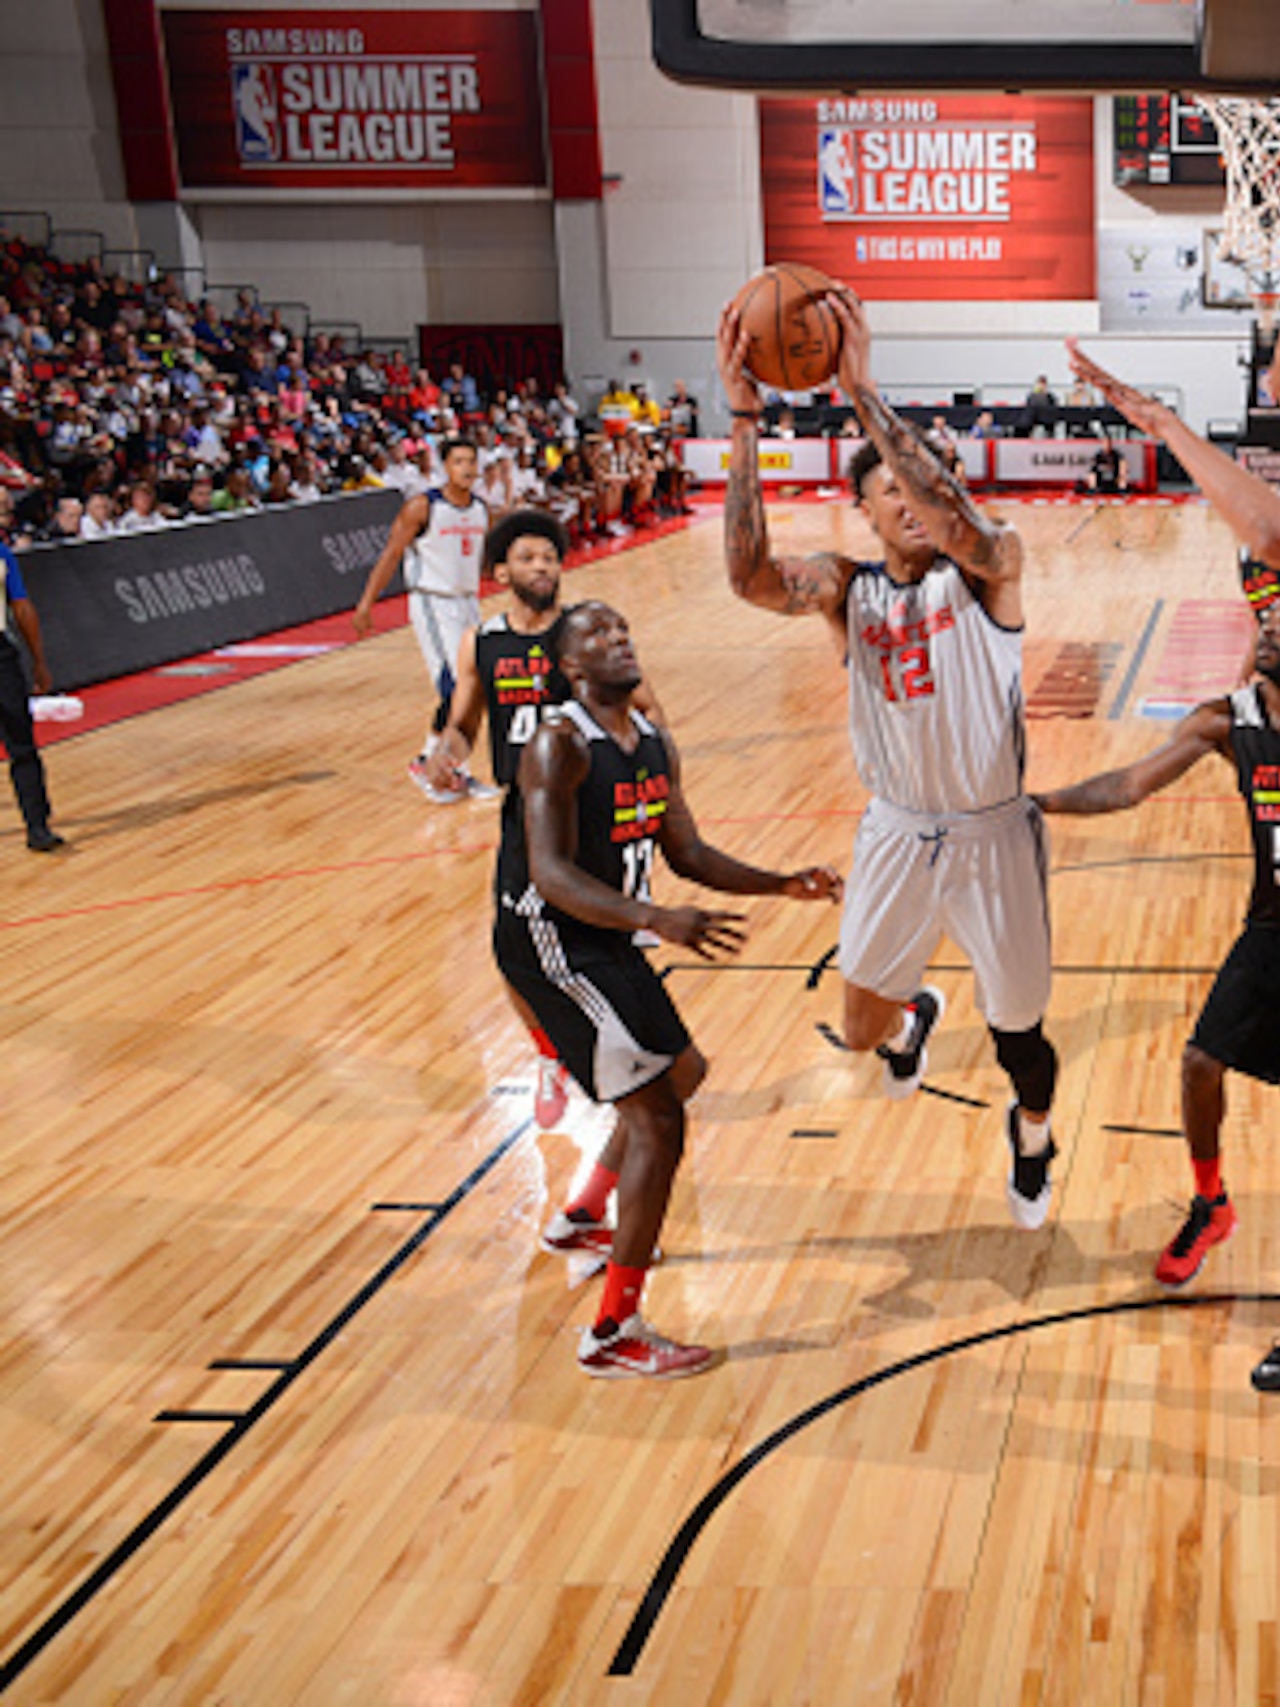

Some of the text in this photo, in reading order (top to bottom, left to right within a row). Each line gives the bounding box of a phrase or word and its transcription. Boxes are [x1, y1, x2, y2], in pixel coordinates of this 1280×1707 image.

[227, 29, 364, 54] SAMSUNG
[282, 65, 480, 112] SUMMER
[817, 100, 937, 122] SAMSUNG
[286, 115, 454, 161] LEAGUE
[862, 131, 1036, 171] SUMMER
[863, 173, 1010, 214] LEAGUE
[321, 524, 388, 575] SAMS
[115, 554, 266, 623] SAMSUNG
[880, 647, 934, 702] 12
